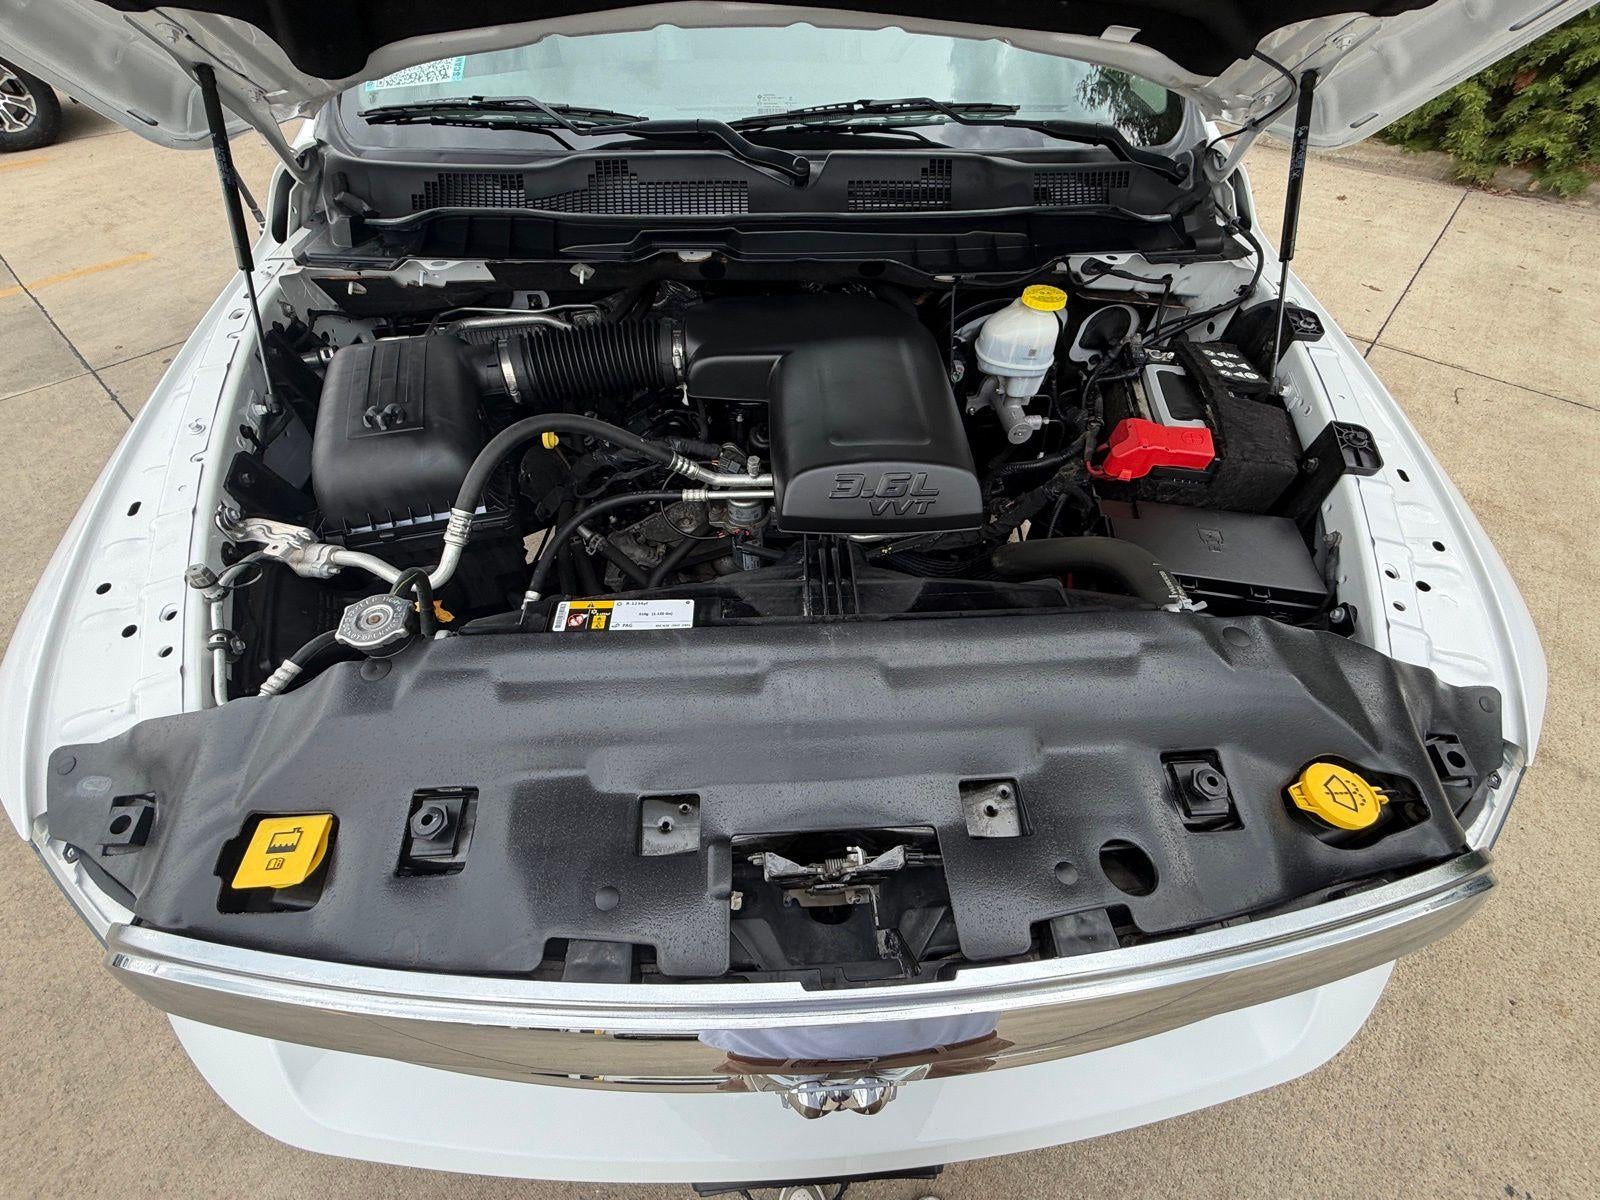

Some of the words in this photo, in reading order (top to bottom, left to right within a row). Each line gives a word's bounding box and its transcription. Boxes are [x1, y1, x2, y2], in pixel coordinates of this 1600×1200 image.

[829, 472, 940, 499] 3.6L
[868, 498, 936, 516] VVT
[361, 630, 385, 641] OPEN
